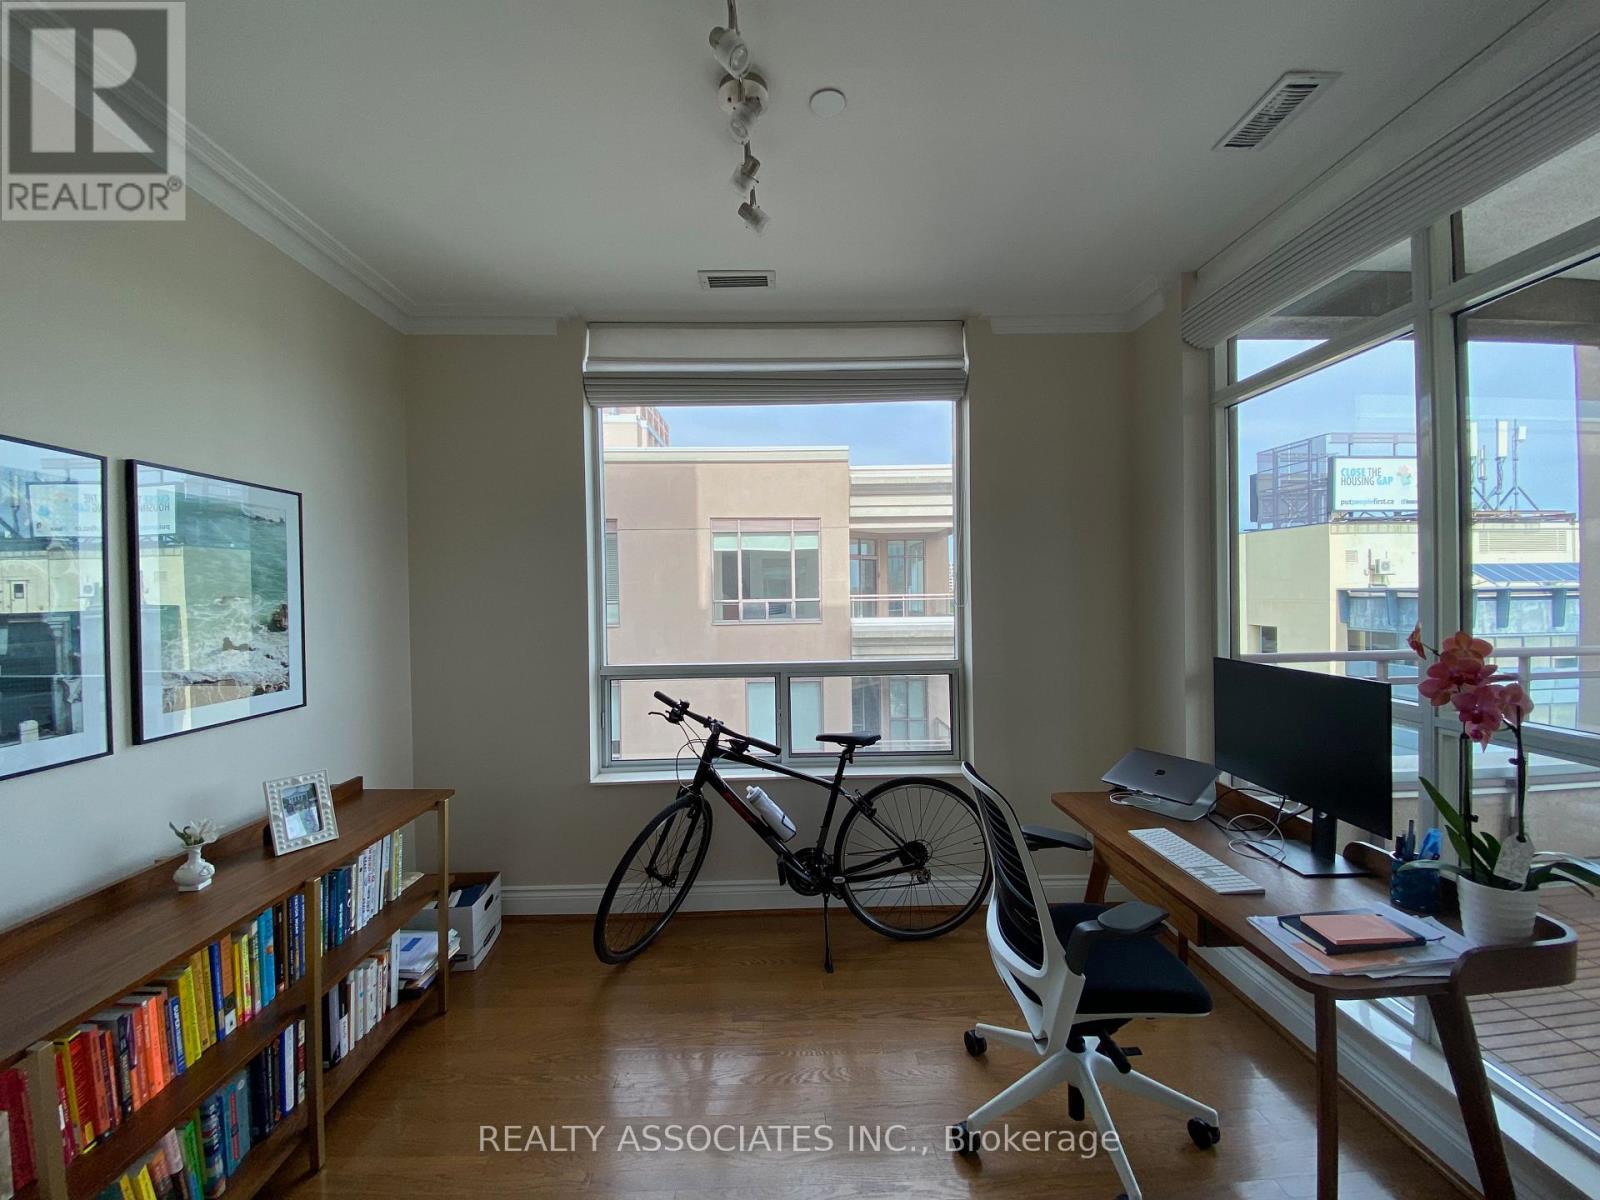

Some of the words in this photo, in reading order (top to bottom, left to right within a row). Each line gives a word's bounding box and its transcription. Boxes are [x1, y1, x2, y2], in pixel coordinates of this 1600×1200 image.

[1341, 467, 1365, 476] CLOSE
[1368, 467, 1382, 476] THE
[1341, 477, 1375, 486] HOUSING
[1377, 476, 1393, 486] GAP
